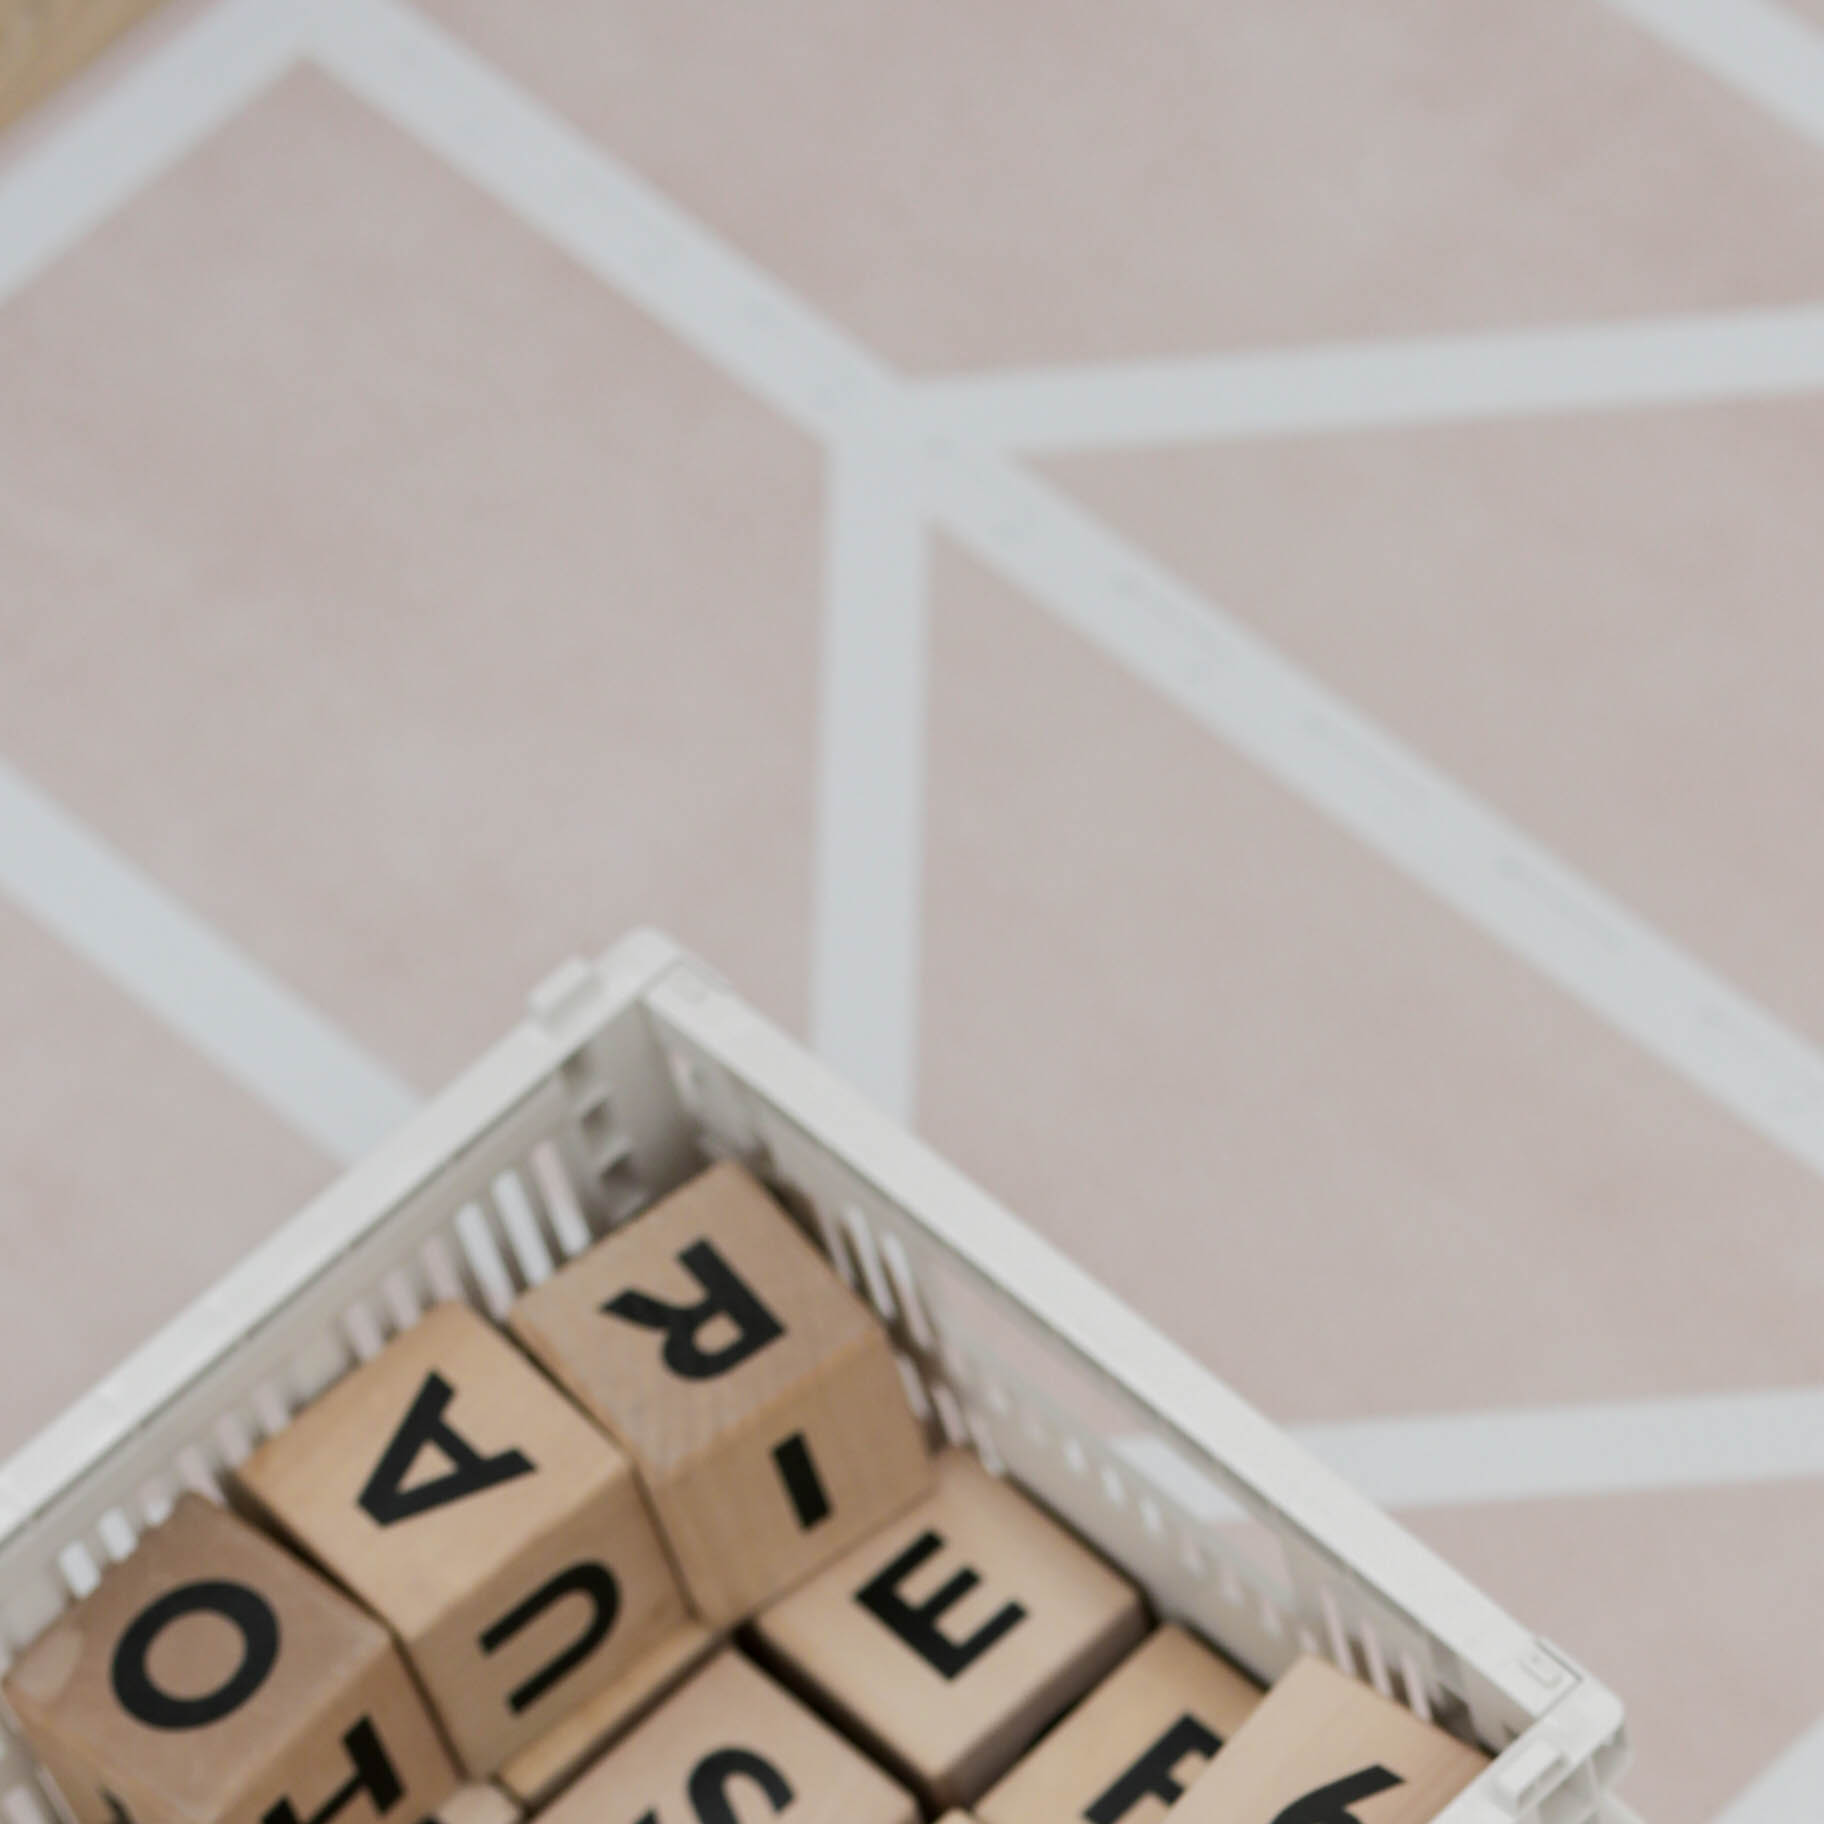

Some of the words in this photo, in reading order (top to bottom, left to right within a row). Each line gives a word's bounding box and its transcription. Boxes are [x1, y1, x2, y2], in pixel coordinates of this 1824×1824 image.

[602, 1240, 786, 1381] R
[358, 1371, 536, 1527] A
[111, 1580, 280, 1731] O
[479, 1562, 620, 1714] U
[854, 1531, 1026, 1680] E
